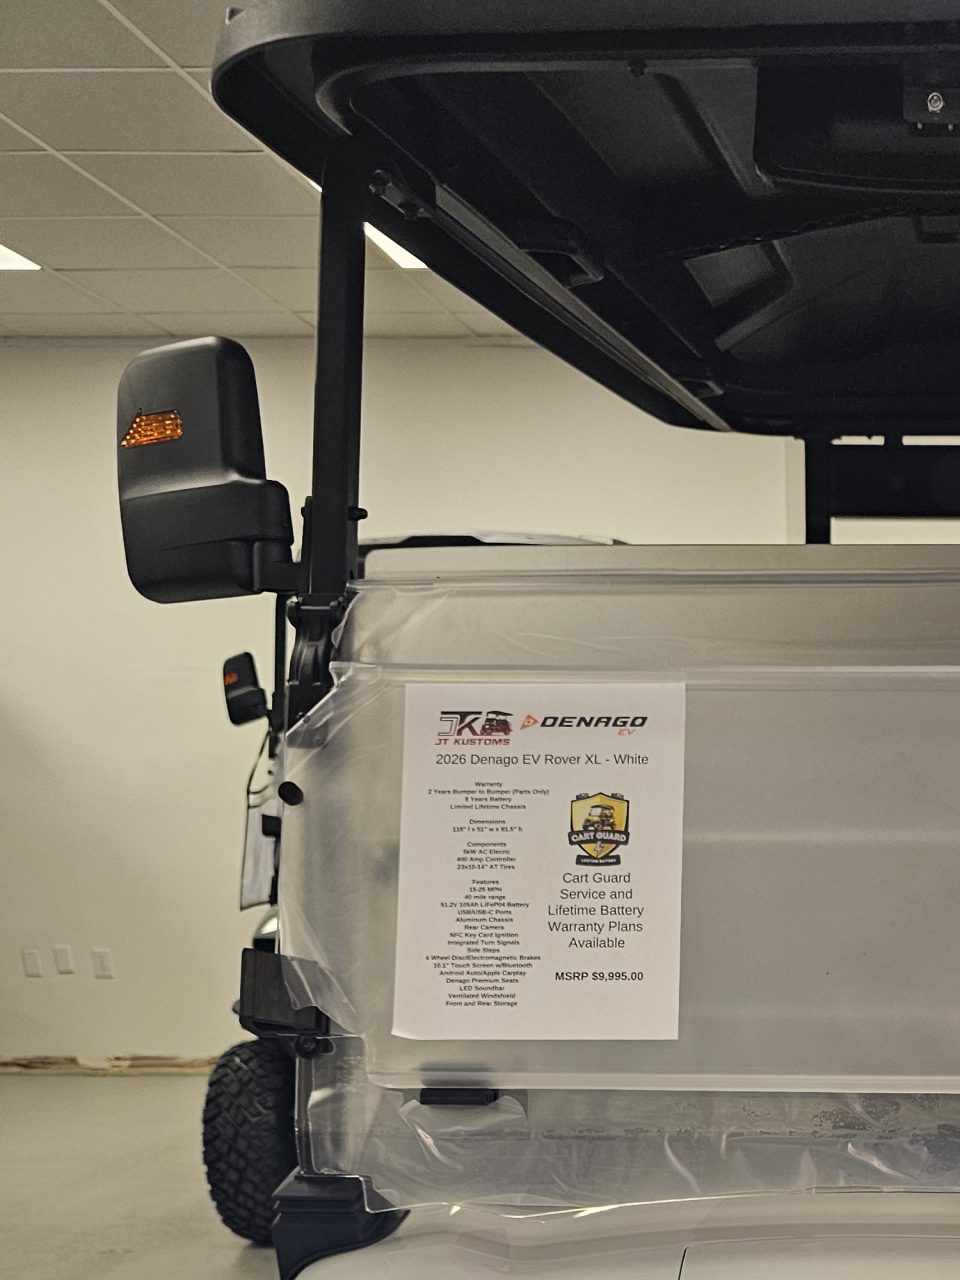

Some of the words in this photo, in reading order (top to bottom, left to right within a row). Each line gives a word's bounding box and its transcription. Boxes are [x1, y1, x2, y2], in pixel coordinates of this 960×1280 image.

[540, 716, 648, 728] DENAGO
[436, 754, 467, 765] 2026
[471, 754, 518, 767] Denago
[523, 754, 540, 764] EV
[545, 754, 581, 765] Rover
[585, 754, 601, 764] XL
[614, 754, 649, 765] White
[571, 832, 594, 842] CART
[596, 831, 627, 842] GUARD
[562, 872, 589, 884] Cart
[592, 872, 631, 884] Guard
[560, 889, 606, 899] Service
[610, 889, 633, 899] and
[548, 905, 596, 916] Lifetime
[600, 905, 644, 918] Battery
[548, 921, 604, 934] Warranty
[609, 921, 643, 932] Plans
[568, 937, 625, 948] Available
[555, 972, 588, 980] MSRP
[592, 971, 644, 982] $9,995.00
